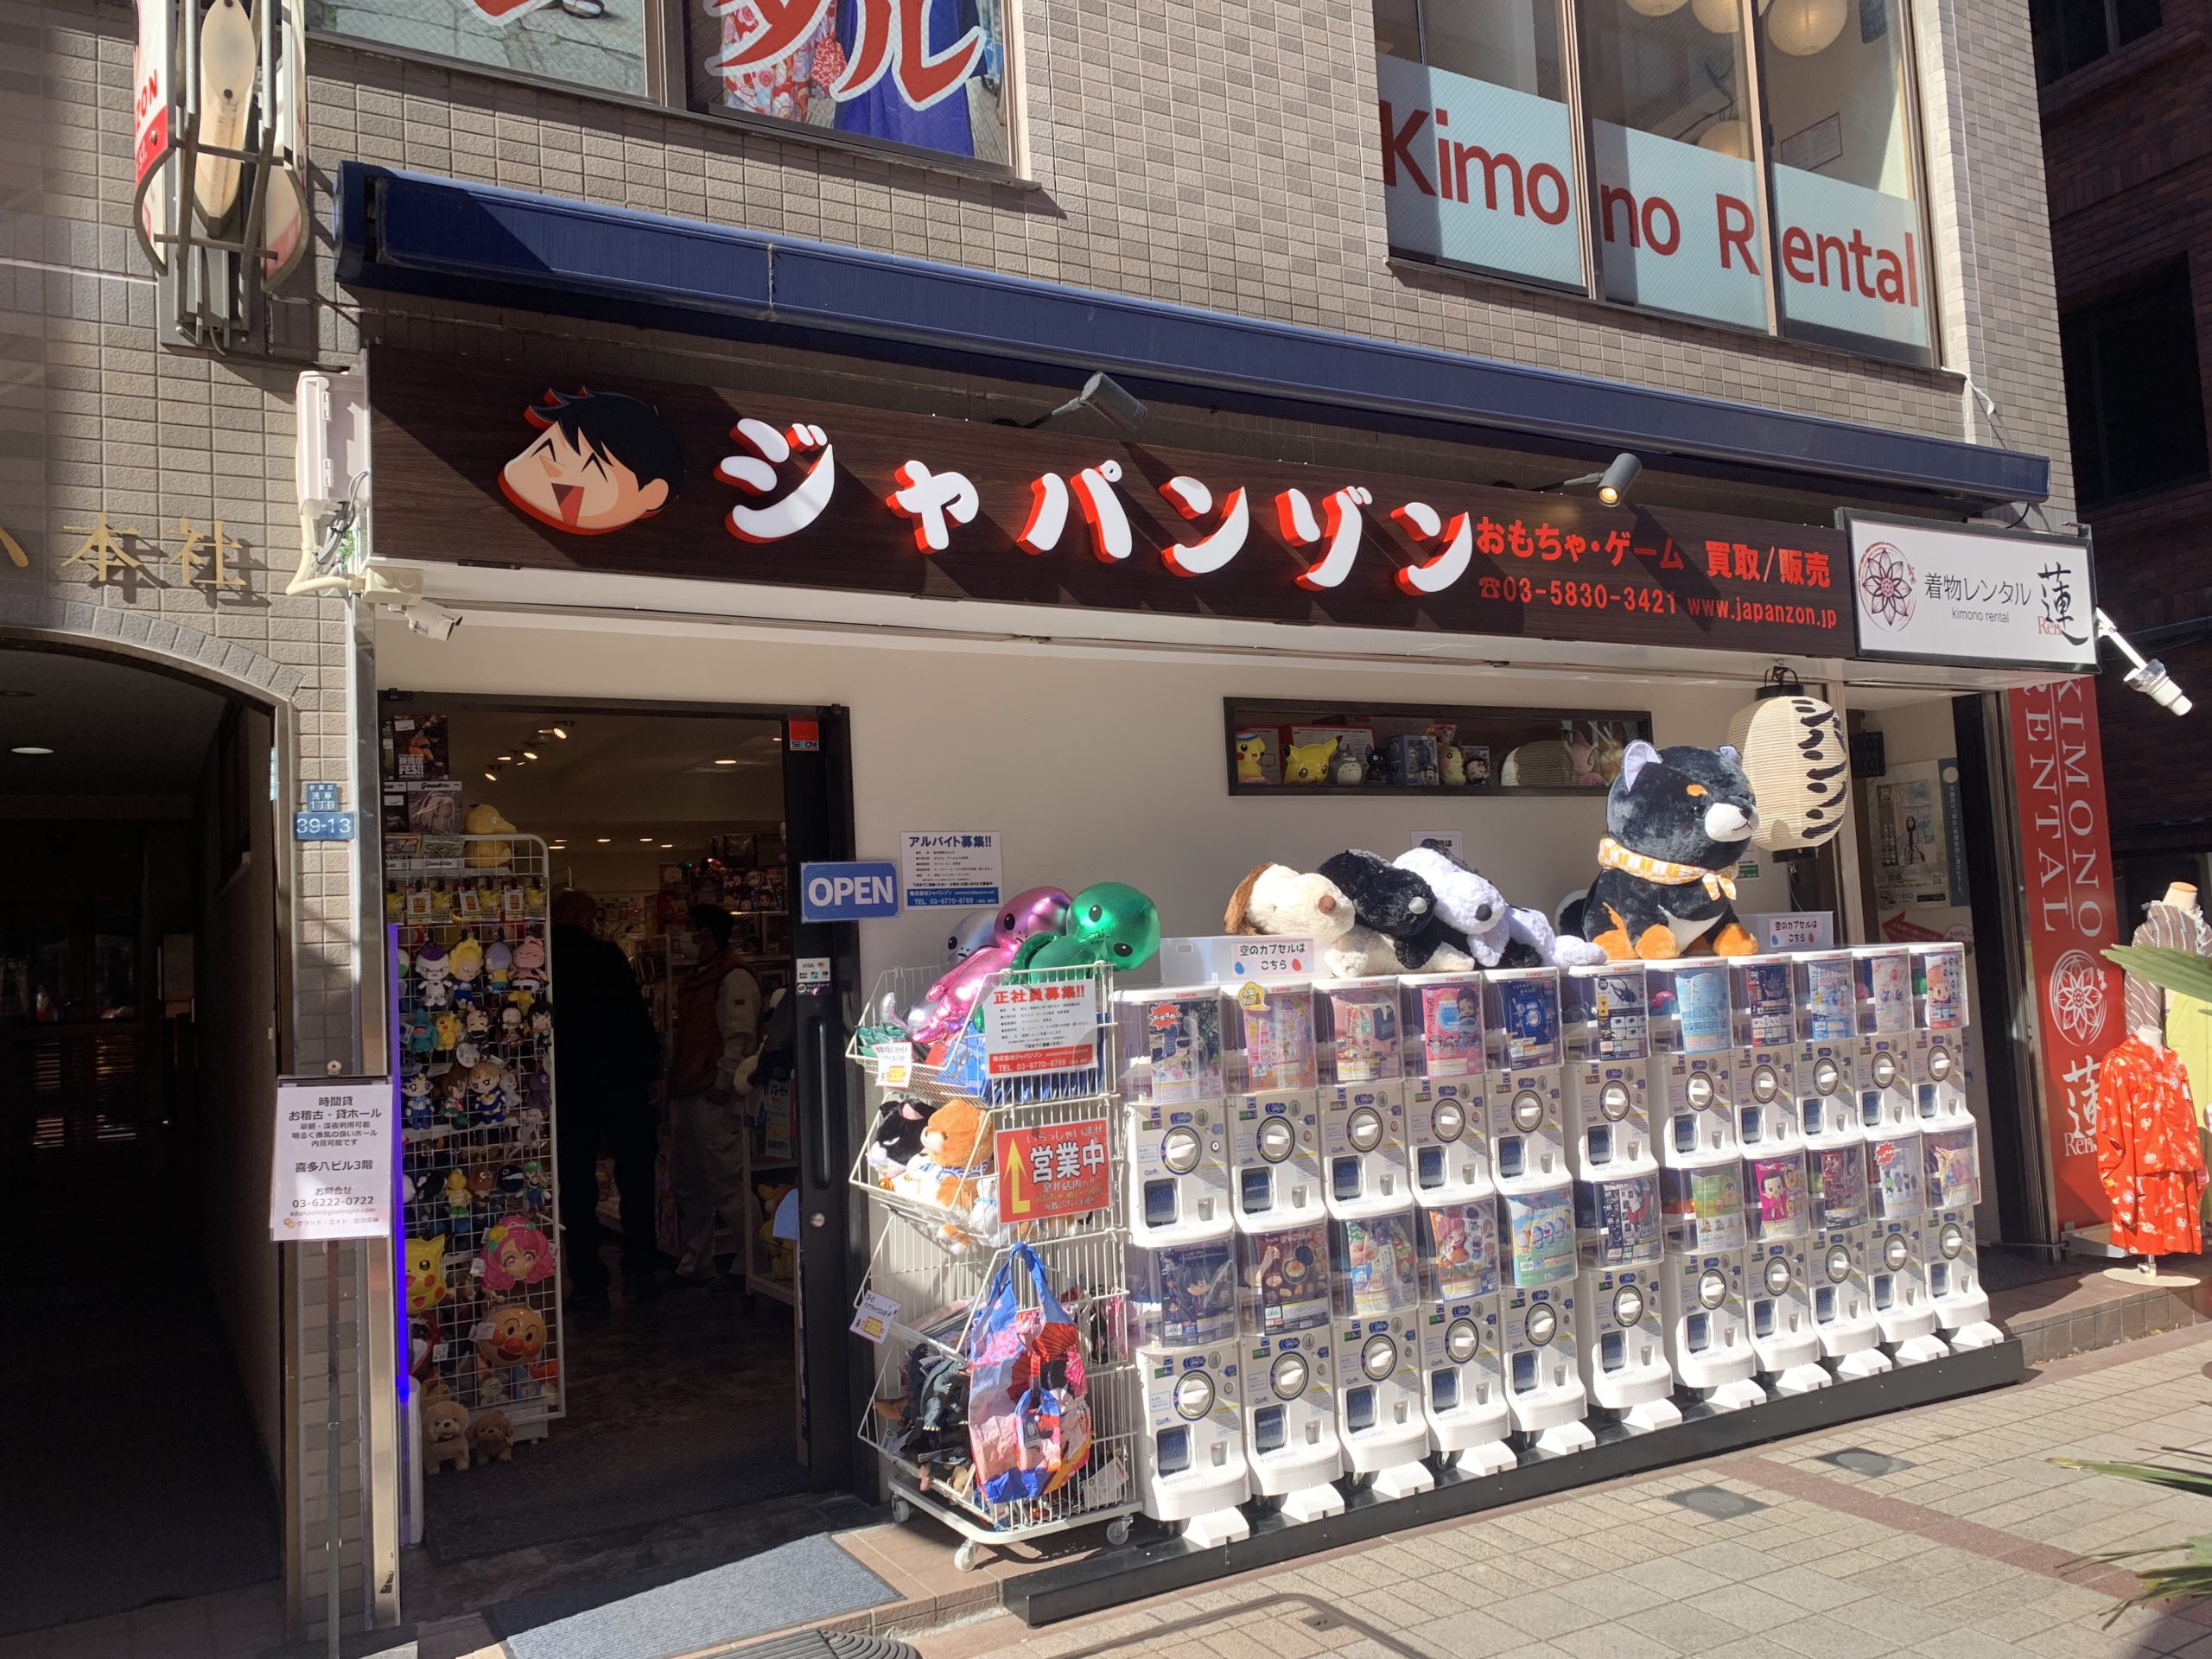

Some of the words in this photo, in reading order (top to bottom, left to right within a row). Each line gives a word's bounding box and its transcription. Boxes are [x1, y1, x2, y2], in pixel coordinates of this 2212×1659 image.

[1379, 100, 1681, 256] Kimono
[1717, 194, 1919, 308] Rental
[713, 418, 1473, 598] ジャパンゾン
[1476, 516, 1686, 570] おもちゃ・ゲーム
[1705, 539, 1831, 588] 買取/販売
[1503, 576, 1676, 614] 03-5830-3421
[1688, 595, 1838, 629] www.japanzon.jp
[1924, 571, 2032, 607] 着物レンタル
[2037, 562, 2088, 646] 蓮
[1952, 607, 1983, 621] kimono
[1986, 609, 2010, 623] rental
[2037, 615, 2062, 636] Ren
[2057, 677, 2102, 938] KIMONO
[296, 817, 351, 834] 39-13
[909, 835, 992, 848] アルバイト募集!!
[808, 875, 893, 907] OPEN
[1775, 920, 1817, 931] 空のカプセルは
[1789, 933, 1806, 943] こちら
[1239, 942, 1306, 957] 空のカプセルは
[1261, 959, 1287, 970] こちら
[994, 985, 1085, 1004] 正社員募集!!
[993, 1052, 1043, 1062] 株式会社ジャパンゾン
[318, 1096, 353, 1107] 時間貸
[289, 1108, 382, 1122] お稽古・貸ホール
[311, 1139, 359, 1147] 内見可能です
[2063, 1132, 2097, 1157] Ren
[296, 1160, 373, 1173] 喜多八ビル3階
[1029, 1137, 1105, 1185] 営業中
[315, 1186, 353, 1196] お問合せ
[292, 1196, 374, 1208] 03-6222-0722
